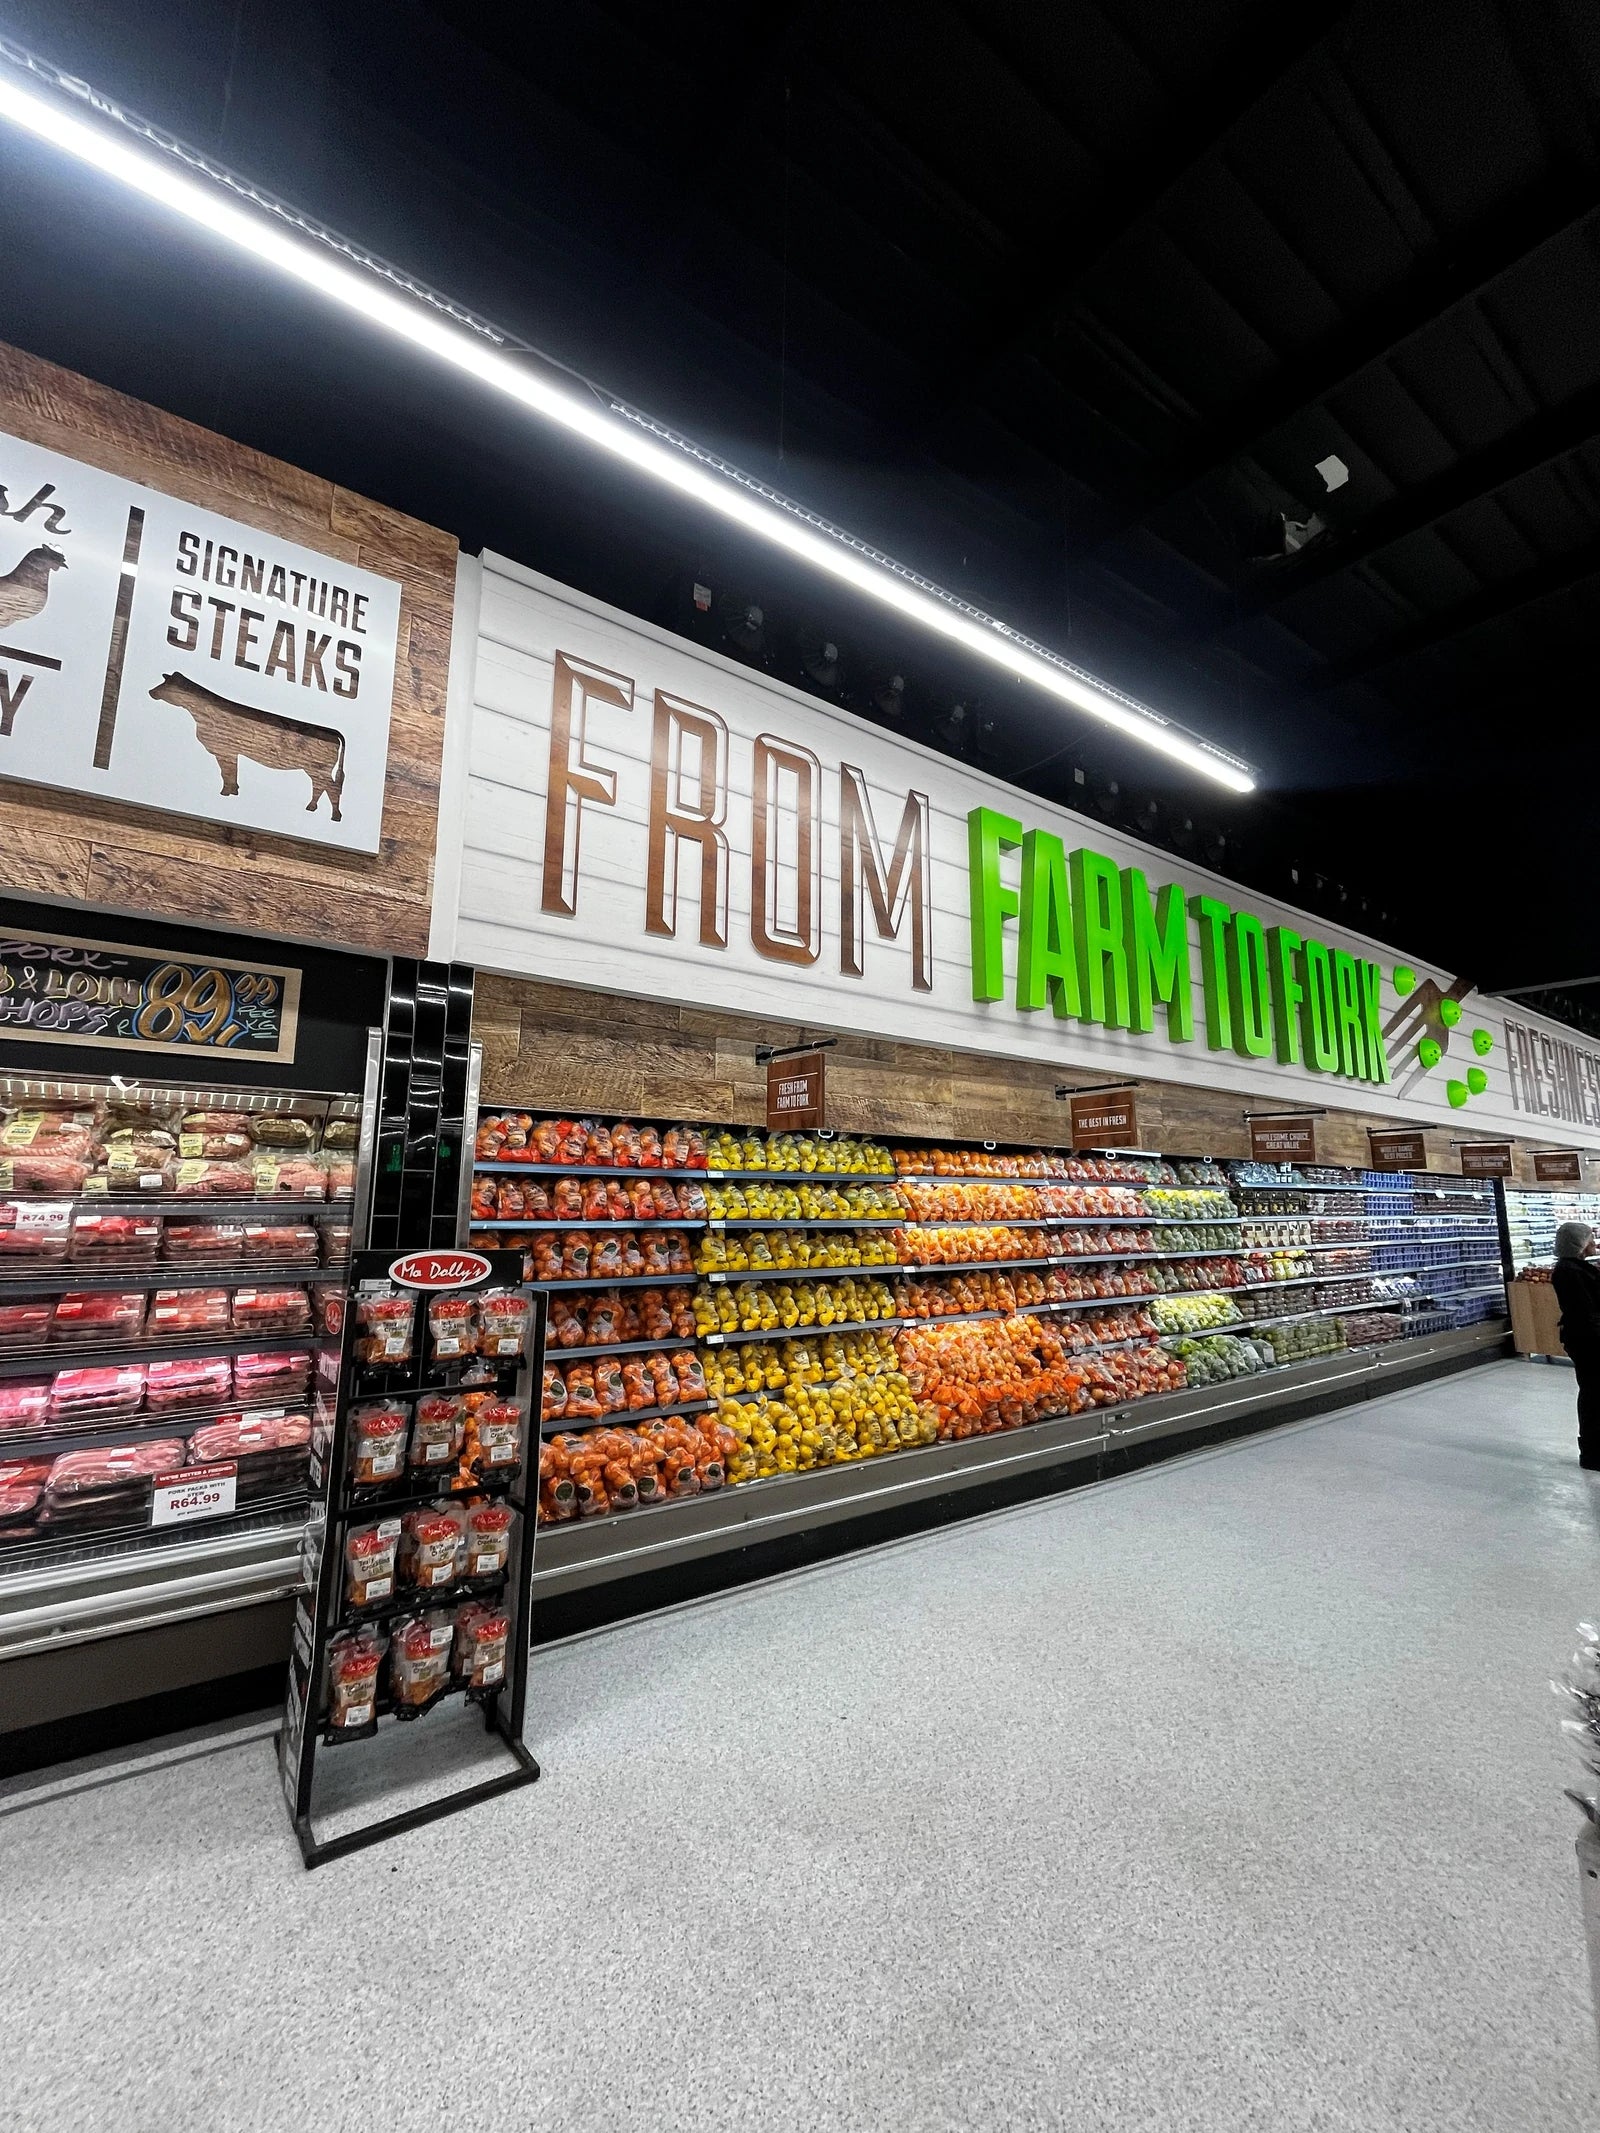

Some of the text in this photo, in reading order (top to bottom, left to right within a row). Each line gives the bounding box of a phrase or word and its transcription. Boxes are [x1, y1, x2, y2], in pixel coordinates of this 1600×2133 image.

[175, 530, 370, 635] SIGNATURE
[166, 585, 363, 700] STEAKS
[540, 649, 1392, 1085] FROM FARM TO FORK
[42, 968, 144, 1010] LOIN
[778, 1080, 794, 1095] FRESH
[777, 1093, 810, 1109] FARM TO FORK
[1078, 1115, 1127, 1128] THE BEST IN FRESH
[22, 1214, 64, 1222] R74.99
[429, 1261, 482, 1283] Dolly's
[170, 1492, 221, 1510] R64.99
